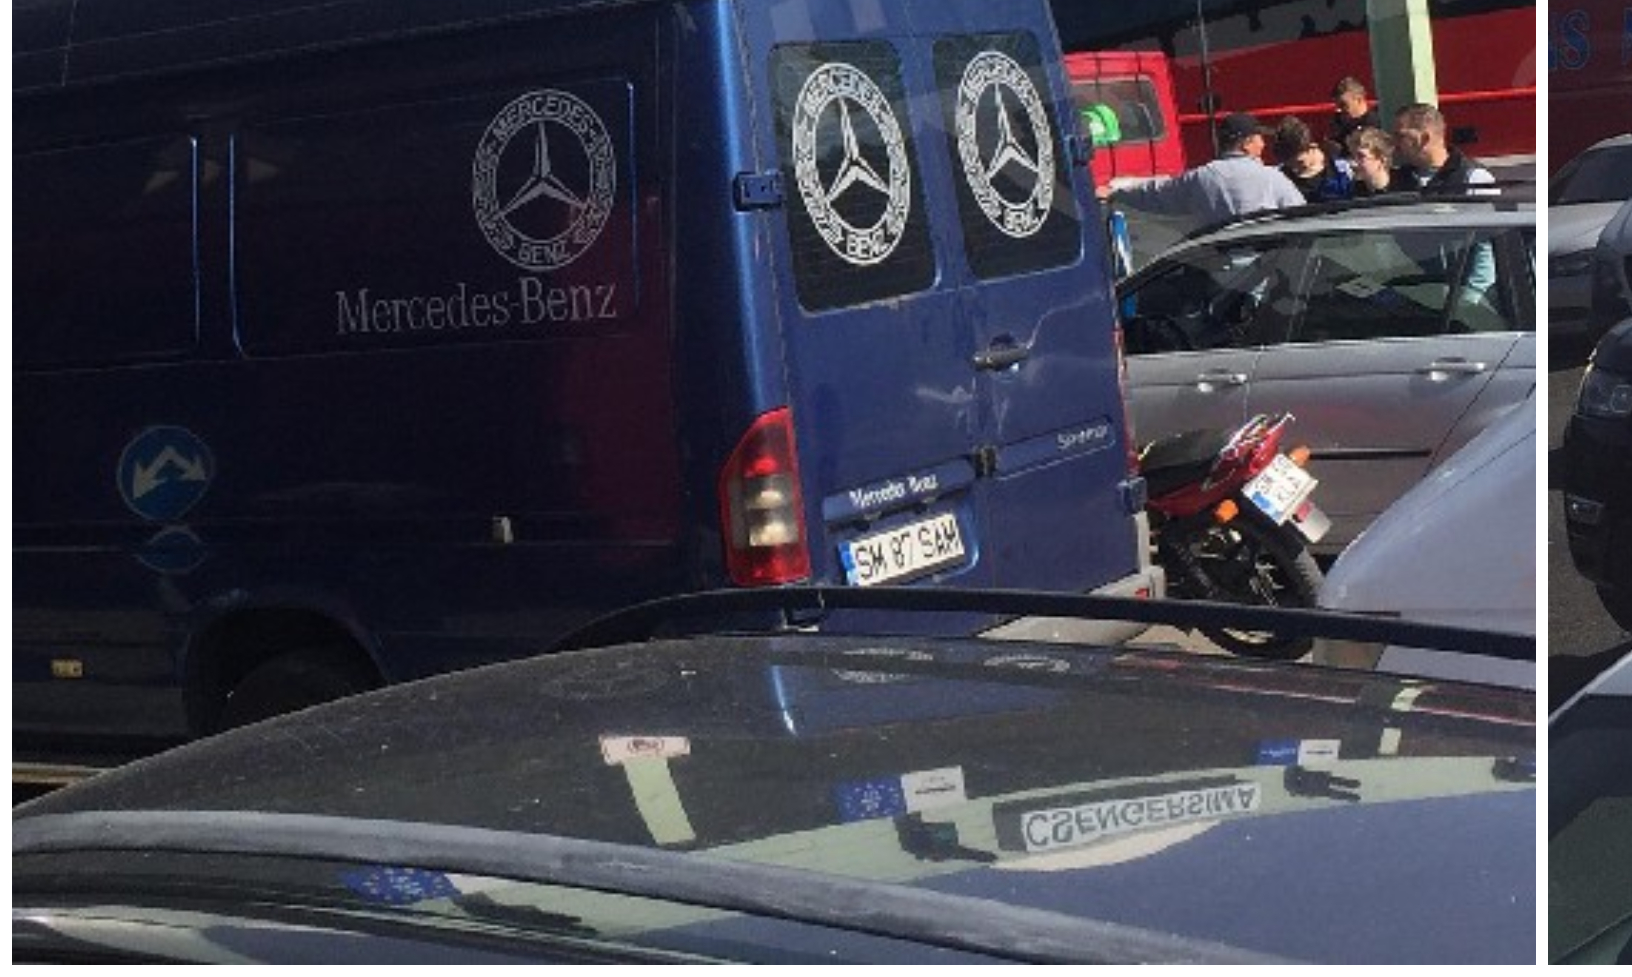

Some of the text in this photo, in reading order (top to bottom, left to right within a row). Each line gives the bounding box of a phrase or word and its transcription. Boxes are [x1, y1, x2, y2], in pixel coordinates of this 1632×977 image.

[336, 276, 617, 335] Mercedes-Benz
[854, 543, 884, 580] SM
[918, 523, 962, 561] SAM
